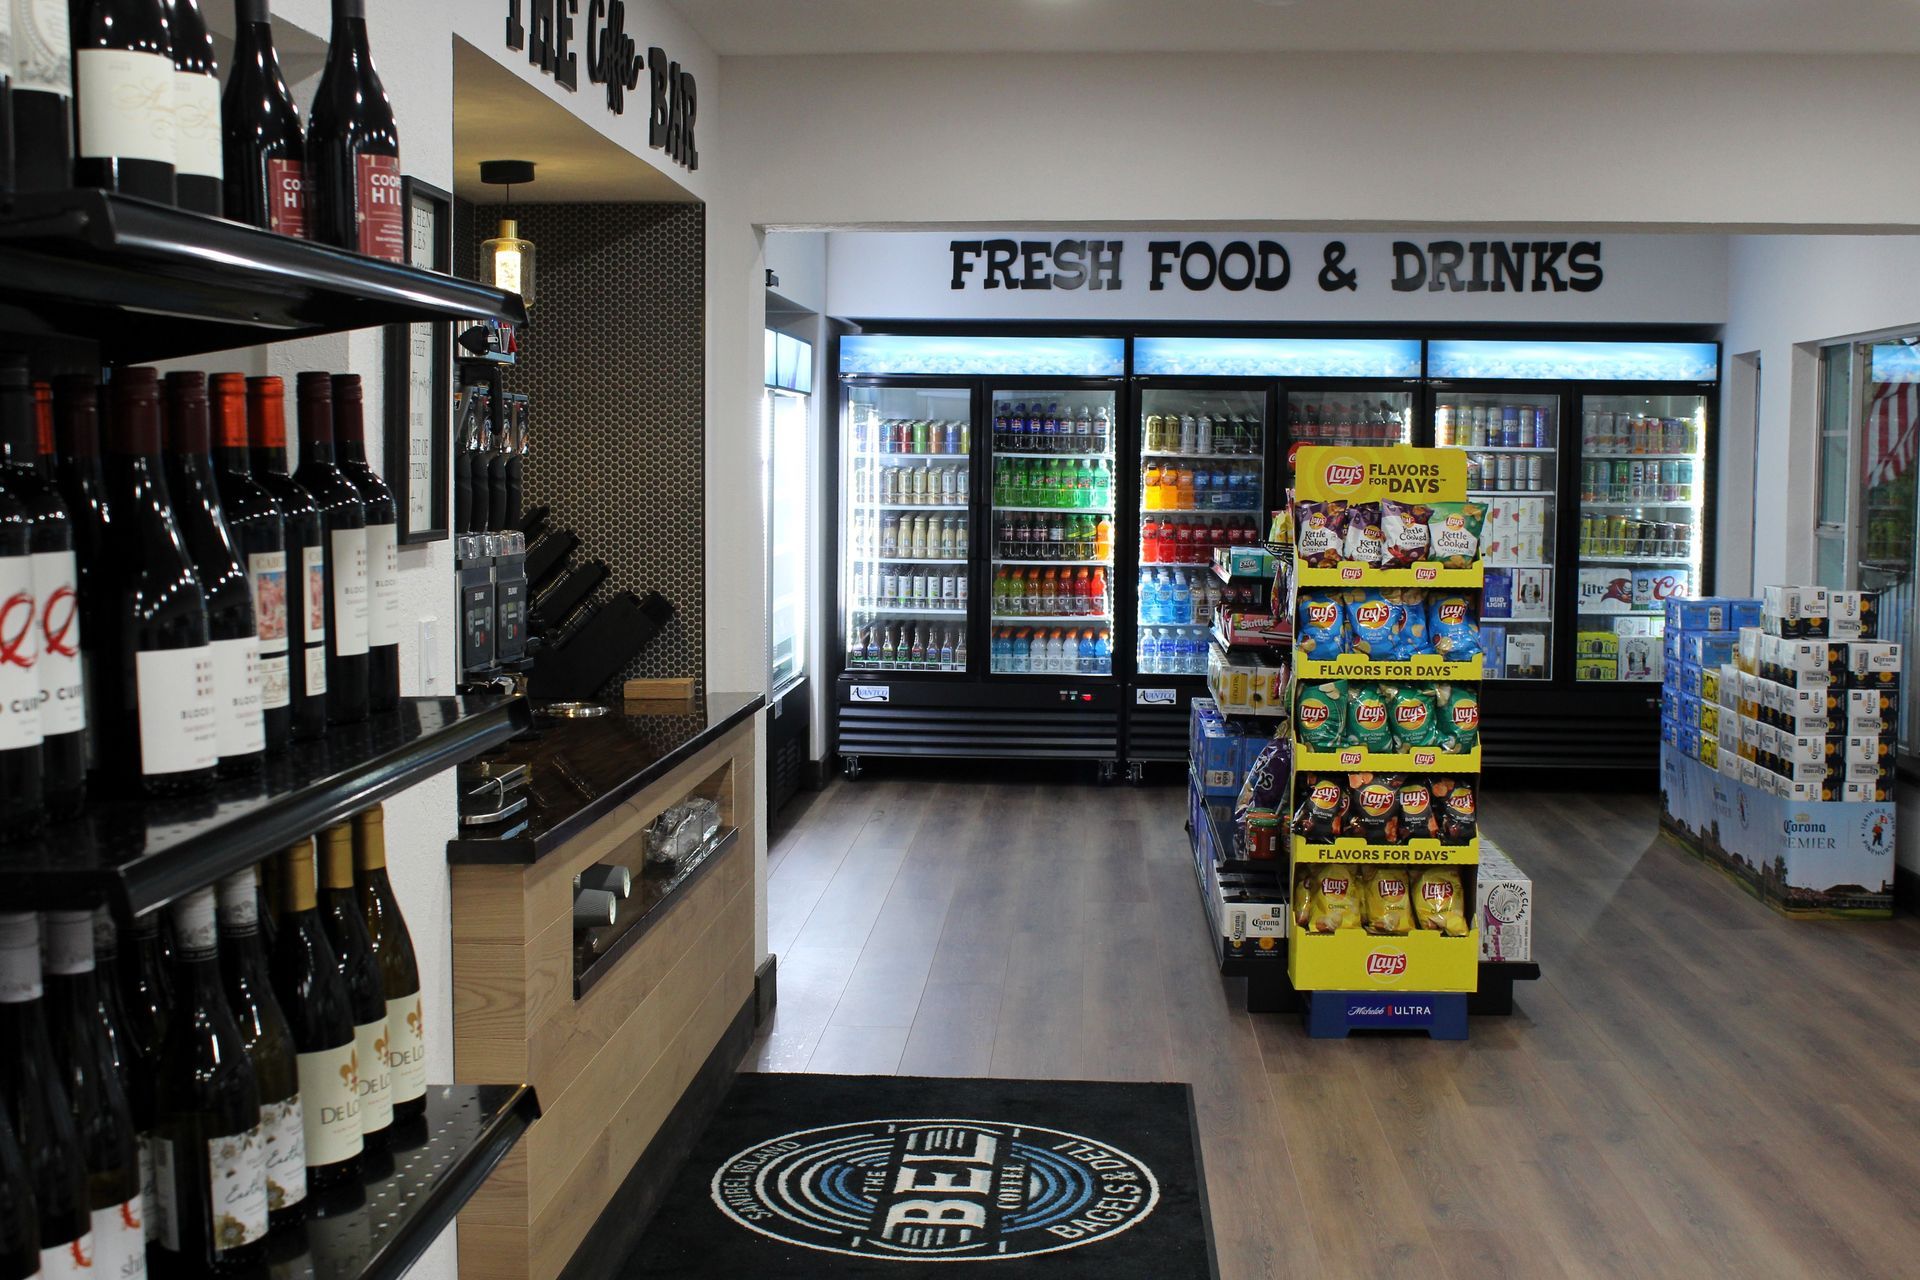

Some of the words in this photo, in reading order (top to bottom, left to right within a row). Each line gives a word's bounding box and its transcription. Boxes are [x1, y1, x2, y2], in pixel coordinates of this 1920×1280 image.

[648, 47, 698, 171] BAR
[950, 239, 1123, 290] FRESH
[1148, 240, 1291, 291] FOOD
[1318, 240, 1357, 292] &
[1391, 241, 1604, 292] DRINKS
[1329, 465, 1363, 486] Lay's
[1369, 464, 1439, 476] FLAVORS
[1369, 478, 1387, 486] FOR
[1302, 539, 1328, 547] Cooked
[1305, 531, 1326, 540] Kettle
[1442, 531, 1467, 540] Kettle
[1360, 540, 1381, 548] Kettl
[1438, 539, 1469, 549] Cooked
[1342, 568, 1361, 579] Lay's
[1417, 569, 1436, 580] Lay's
[1583, 583, 1604, 597] Lite
[1309, 606, 1334, 622] Lay's
[1360, 605, 1387, 622] Lay's
[1320, 665, 1381, 676] FLAVORS
[1385, 665, 1411, 676] FOR
[1138, 690, 1175, 703] AVANTCO
[1300, 706, 1326, 722] Lay's
[1358, 705, 1384, 722] Lay's
[1398, 705, 1424, 722] Lay's
[1455, 706, 1477, 723] Lay's
[1311, 786, 1338, 801] Lay's
[1363, 790, 1392, 808] Lay's
[1400, 790, 1426, 806] Lay's
[1784, 819, 1826, 835] Corona
[1319, 850, 1379, 860] FLAVORS
[1384, 850, 1410, 861] FOR
[1323, 878, 1347, 895] Lay's
[1502, 883, 1526, 897] WHITE
[1515, 897, 1528, 921] CLAW
[1252, 918, 1279, 927] Corona
[1369, 954, 1404, 974] Lay's
[1348, 1006, 1385, 1016] Michelob
[1394, 1007, 1431, 1015] ULTRA
[728, 1139, 801, 1174] ISLAND
[1052, 1141, 1128, 1171] DELI
[863, 1170, 888, 1194] THE
[882, 1132, 998, 1239] BEL
[723, 1177, 774, 1220] SANIBEL
[1046, 1183, 1143, 1239] BAGELS
